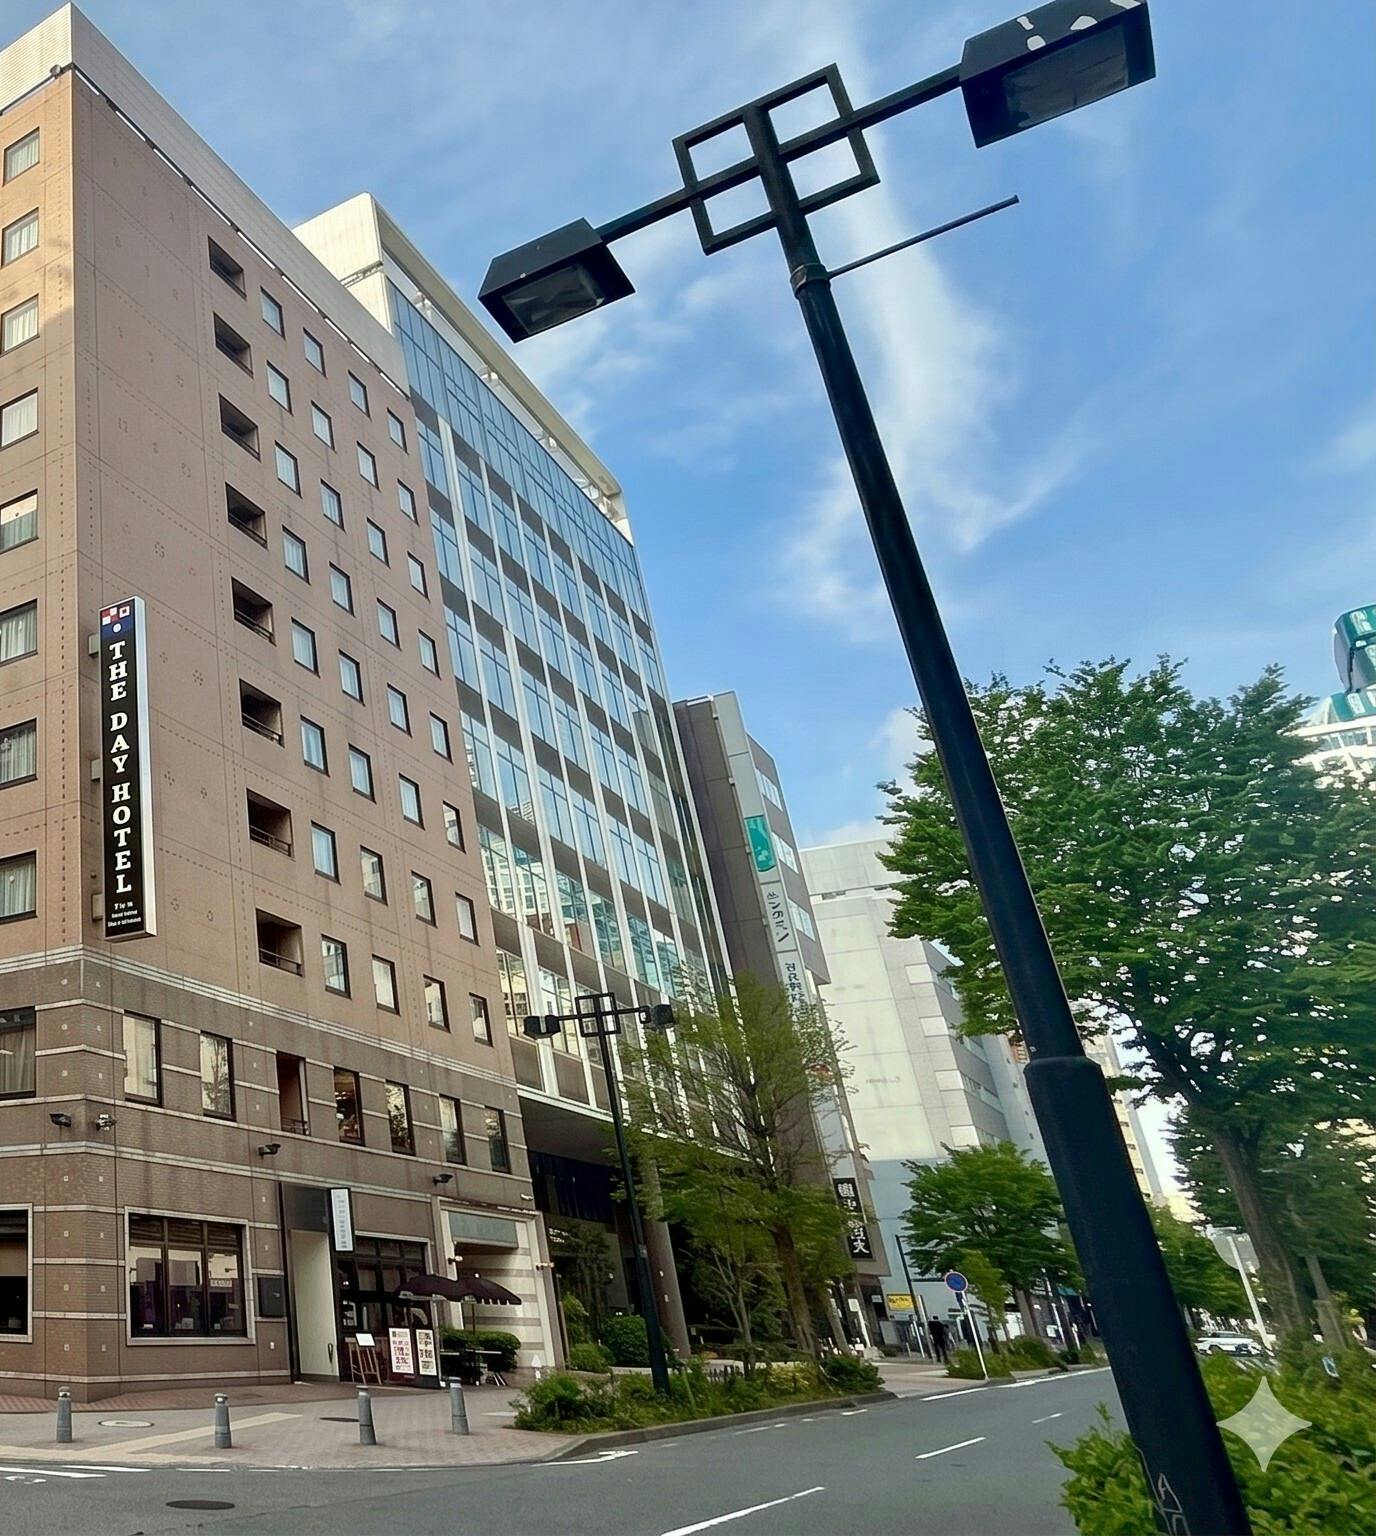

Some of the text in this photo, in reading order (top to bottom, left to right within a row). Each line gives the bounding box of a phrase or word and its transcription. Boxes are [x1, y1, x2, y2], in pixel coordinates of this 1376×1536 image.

[108, 640, 128, 701] THE
[110, 712, 130, 774] DAY
[111, 782, 132, 894] HOTEL
